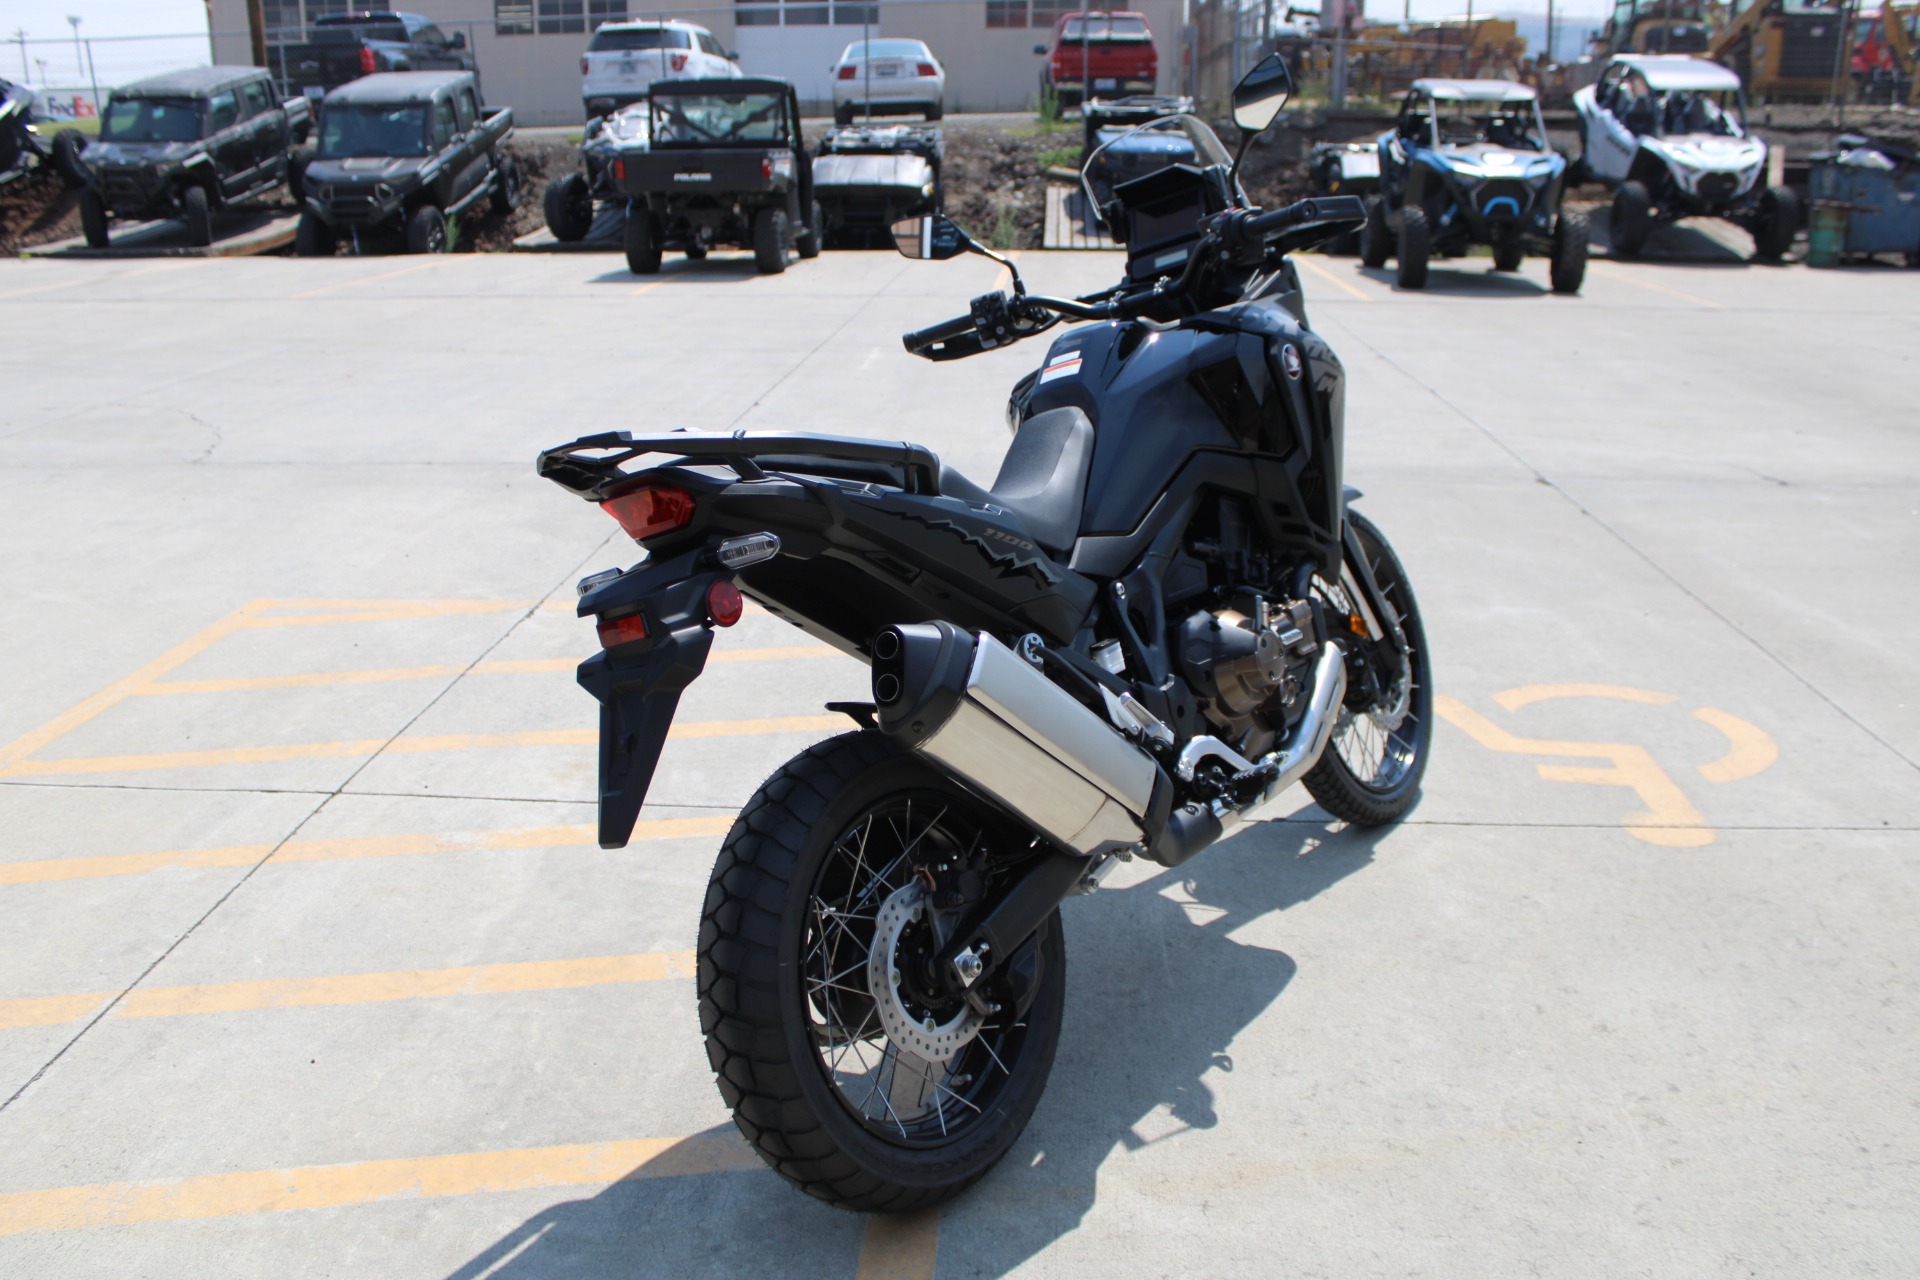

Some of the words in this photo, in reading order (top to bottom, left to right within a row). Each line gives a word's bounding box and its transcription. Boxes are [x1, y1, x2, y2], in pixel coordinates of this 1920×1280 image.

[47, 96, 96, 117] FedEx
[673, 172, 713, 182] POLARIS
[983, 527, 1034, 551] 1100
